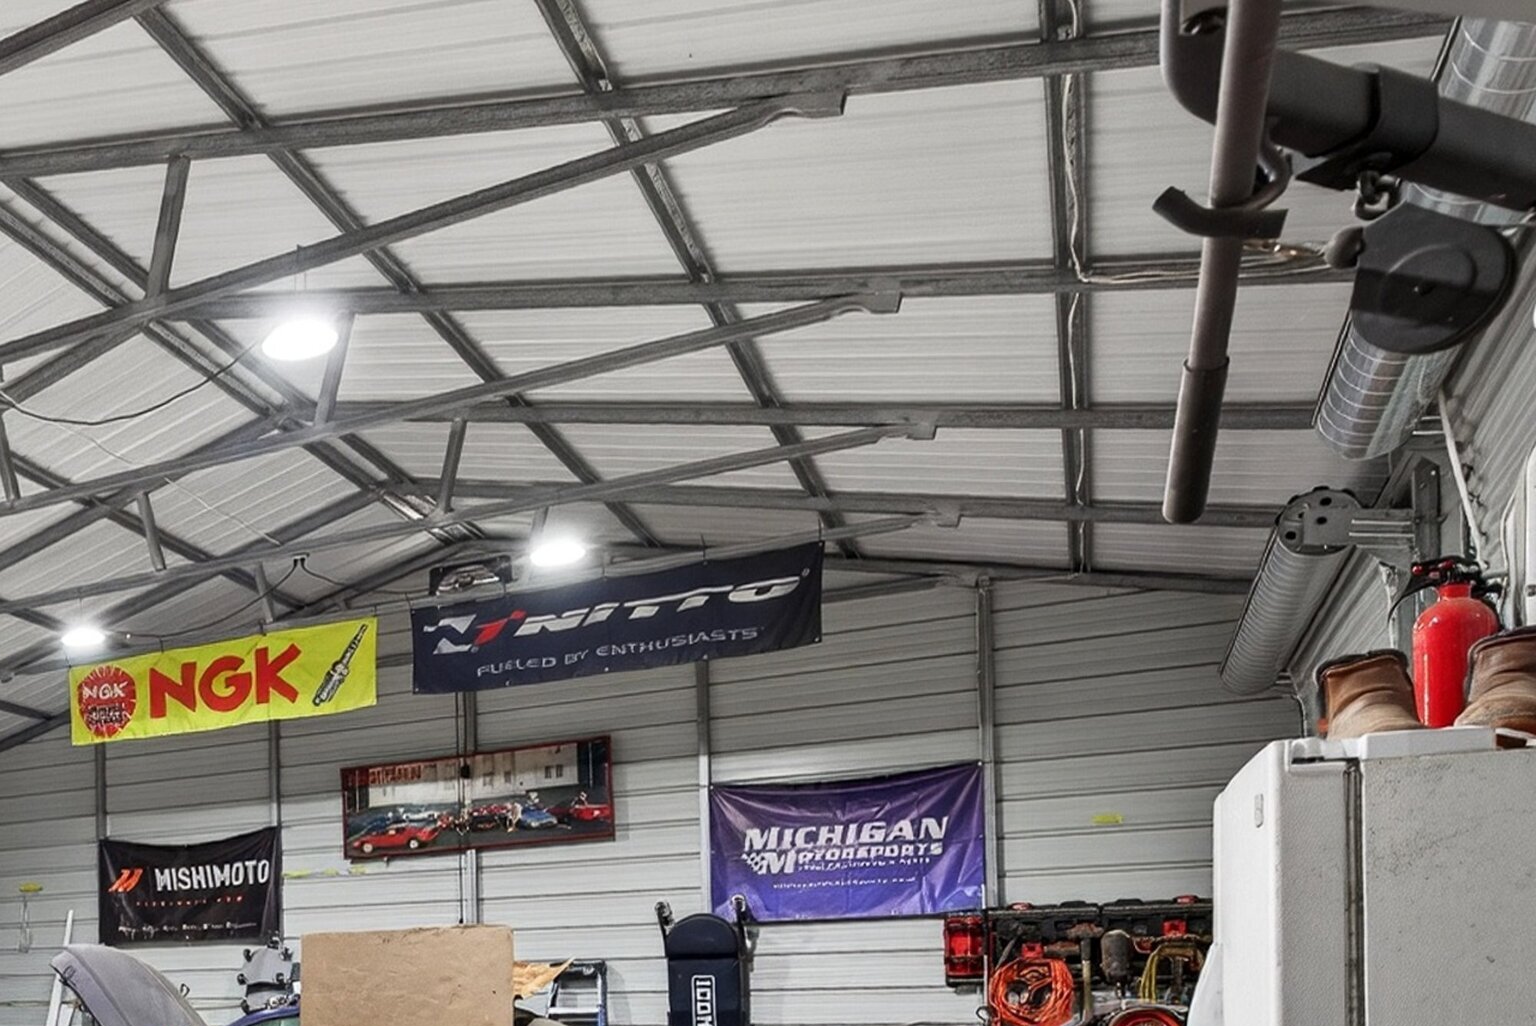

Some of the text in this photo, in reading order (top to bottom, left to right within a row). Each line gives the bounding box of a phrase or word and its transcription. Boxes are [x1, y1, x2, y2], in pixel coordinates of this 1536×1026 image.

[515, 575, 801, 637] NITTO
[477, 627, 760, 677] FUELED BY ENTHUSIASTS
[82, 681, 128, 700] NGK
[149, 643, 302, 719] NGK
[744, 816, 950, 852] MICHIGAN
[154, 859, 269, 892] MISHIMOTO
